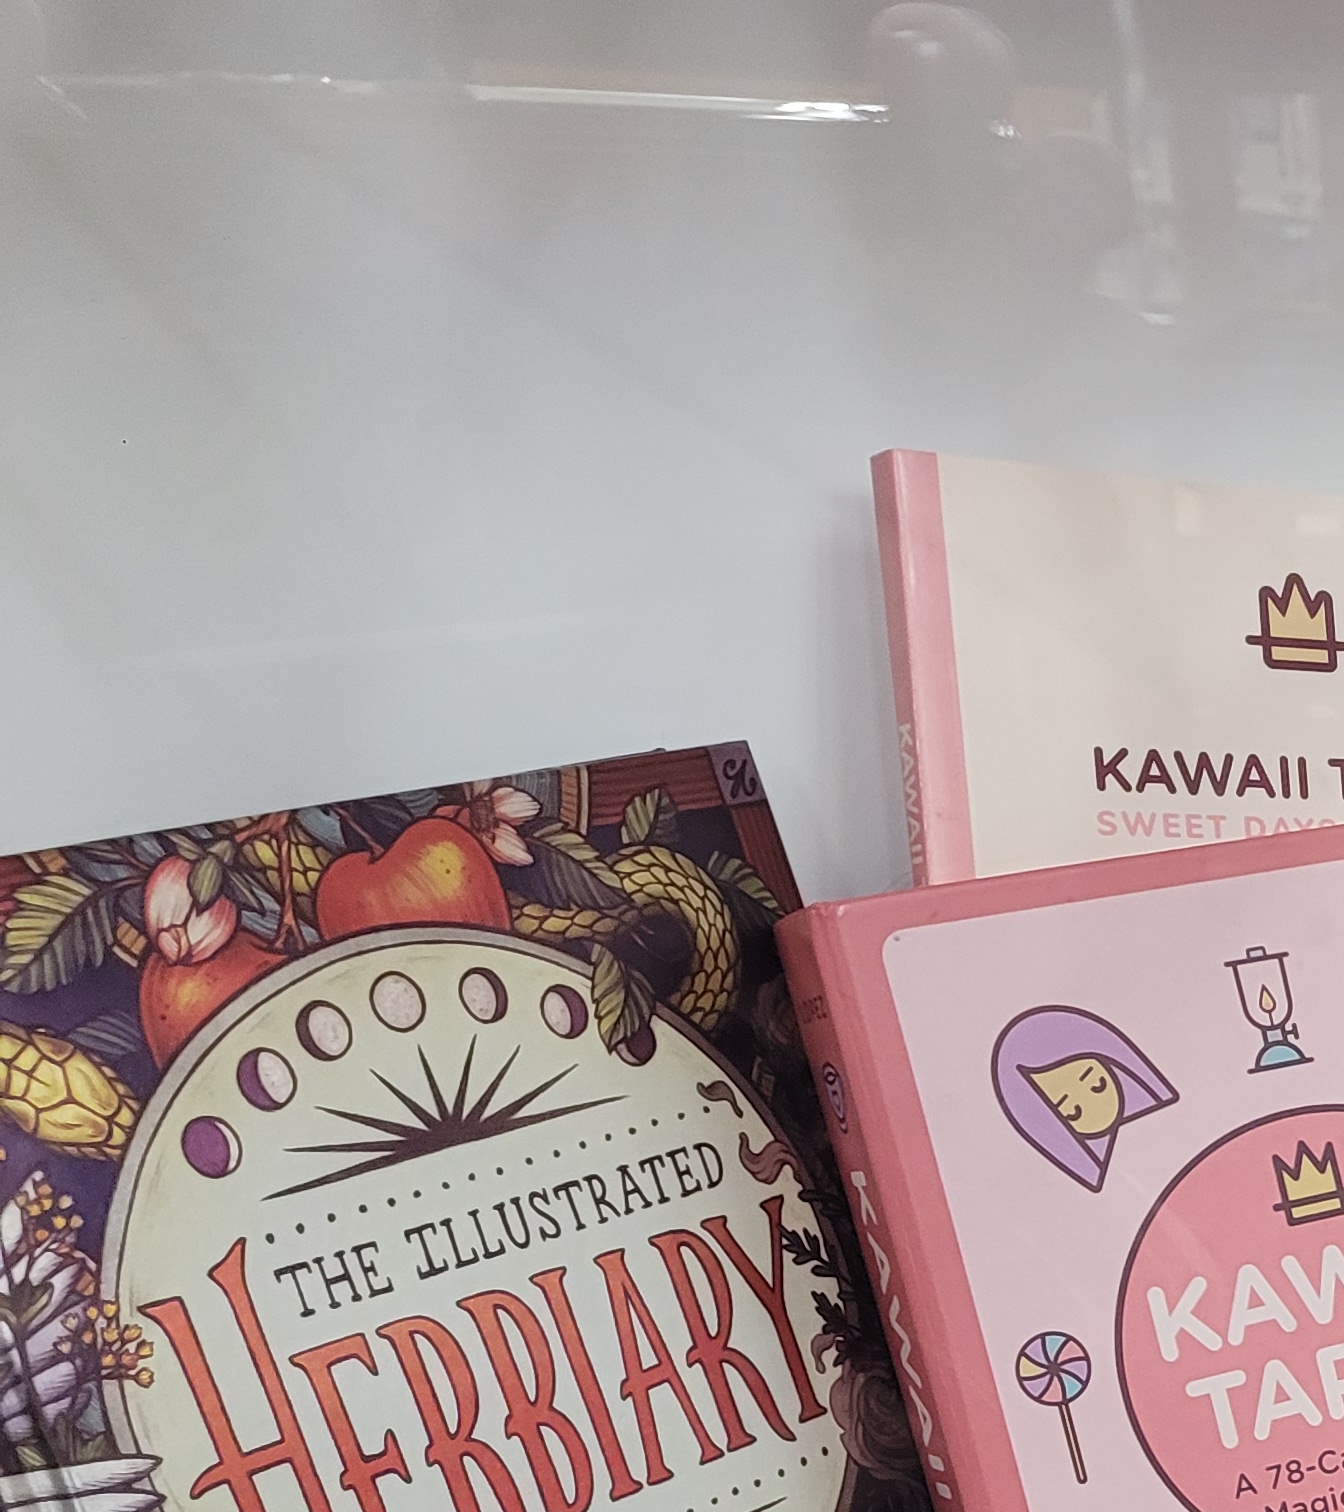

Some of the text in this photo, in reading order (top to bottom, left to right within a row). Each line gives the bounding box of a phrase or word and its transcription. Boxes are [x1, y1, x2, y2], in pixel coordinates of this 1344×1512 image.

[899, 723, 923, 865] KAWAII
[1094, 746, 1308, 799] KAWAII
[1097, 810, 1226, 839] SWEET
[275, 1141, 724, 1318] THE ILLUSTRATED
[1234, 1473, 1257, 1499] A
